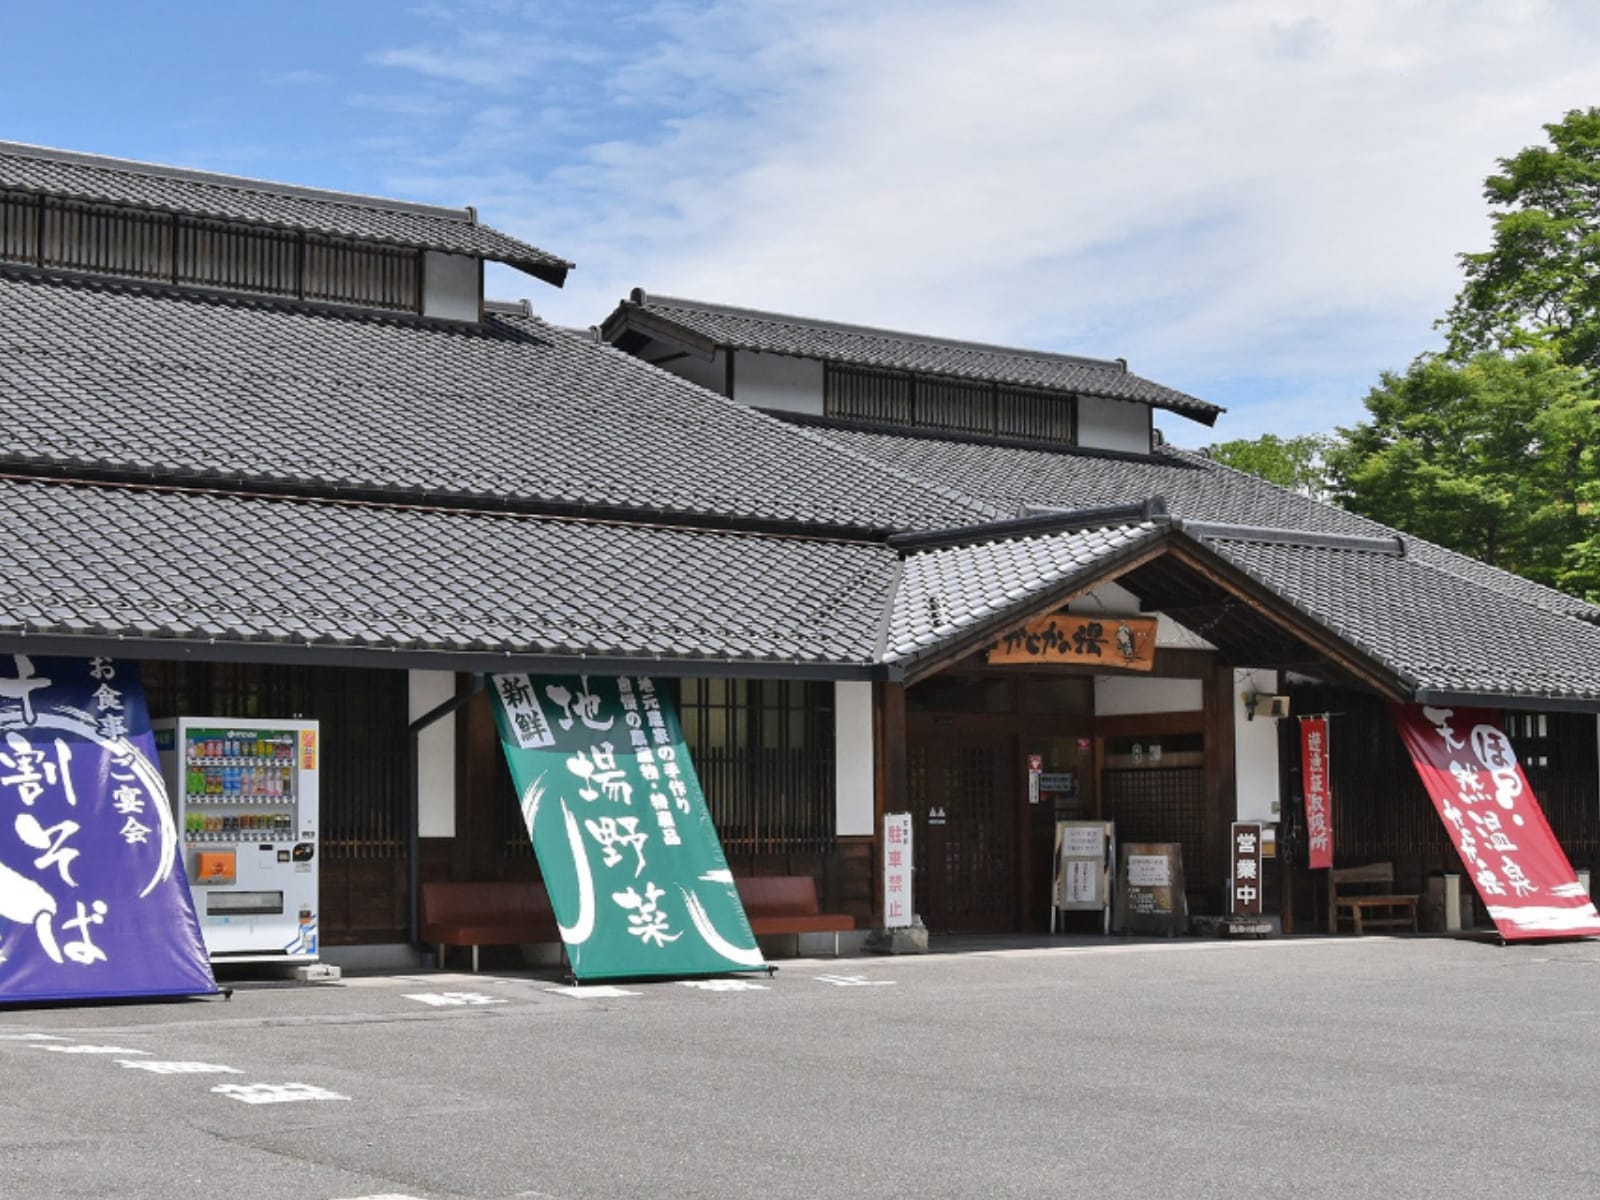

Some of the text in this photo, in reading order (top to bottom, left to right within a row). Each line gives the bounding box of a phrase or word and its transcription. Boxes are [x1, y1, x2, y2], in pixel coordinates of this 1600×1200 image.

[502, 676, 548, 743] 新鮮
[0, 654, 108, 965] 十割そば
[545, 674, 685, 948] 地場野菜
[888, 825, 903, 918] 駐車禁止
[1236, 832, 1258, 906] 営業中
[1423, 705, 1539, 897] 天然温泉
